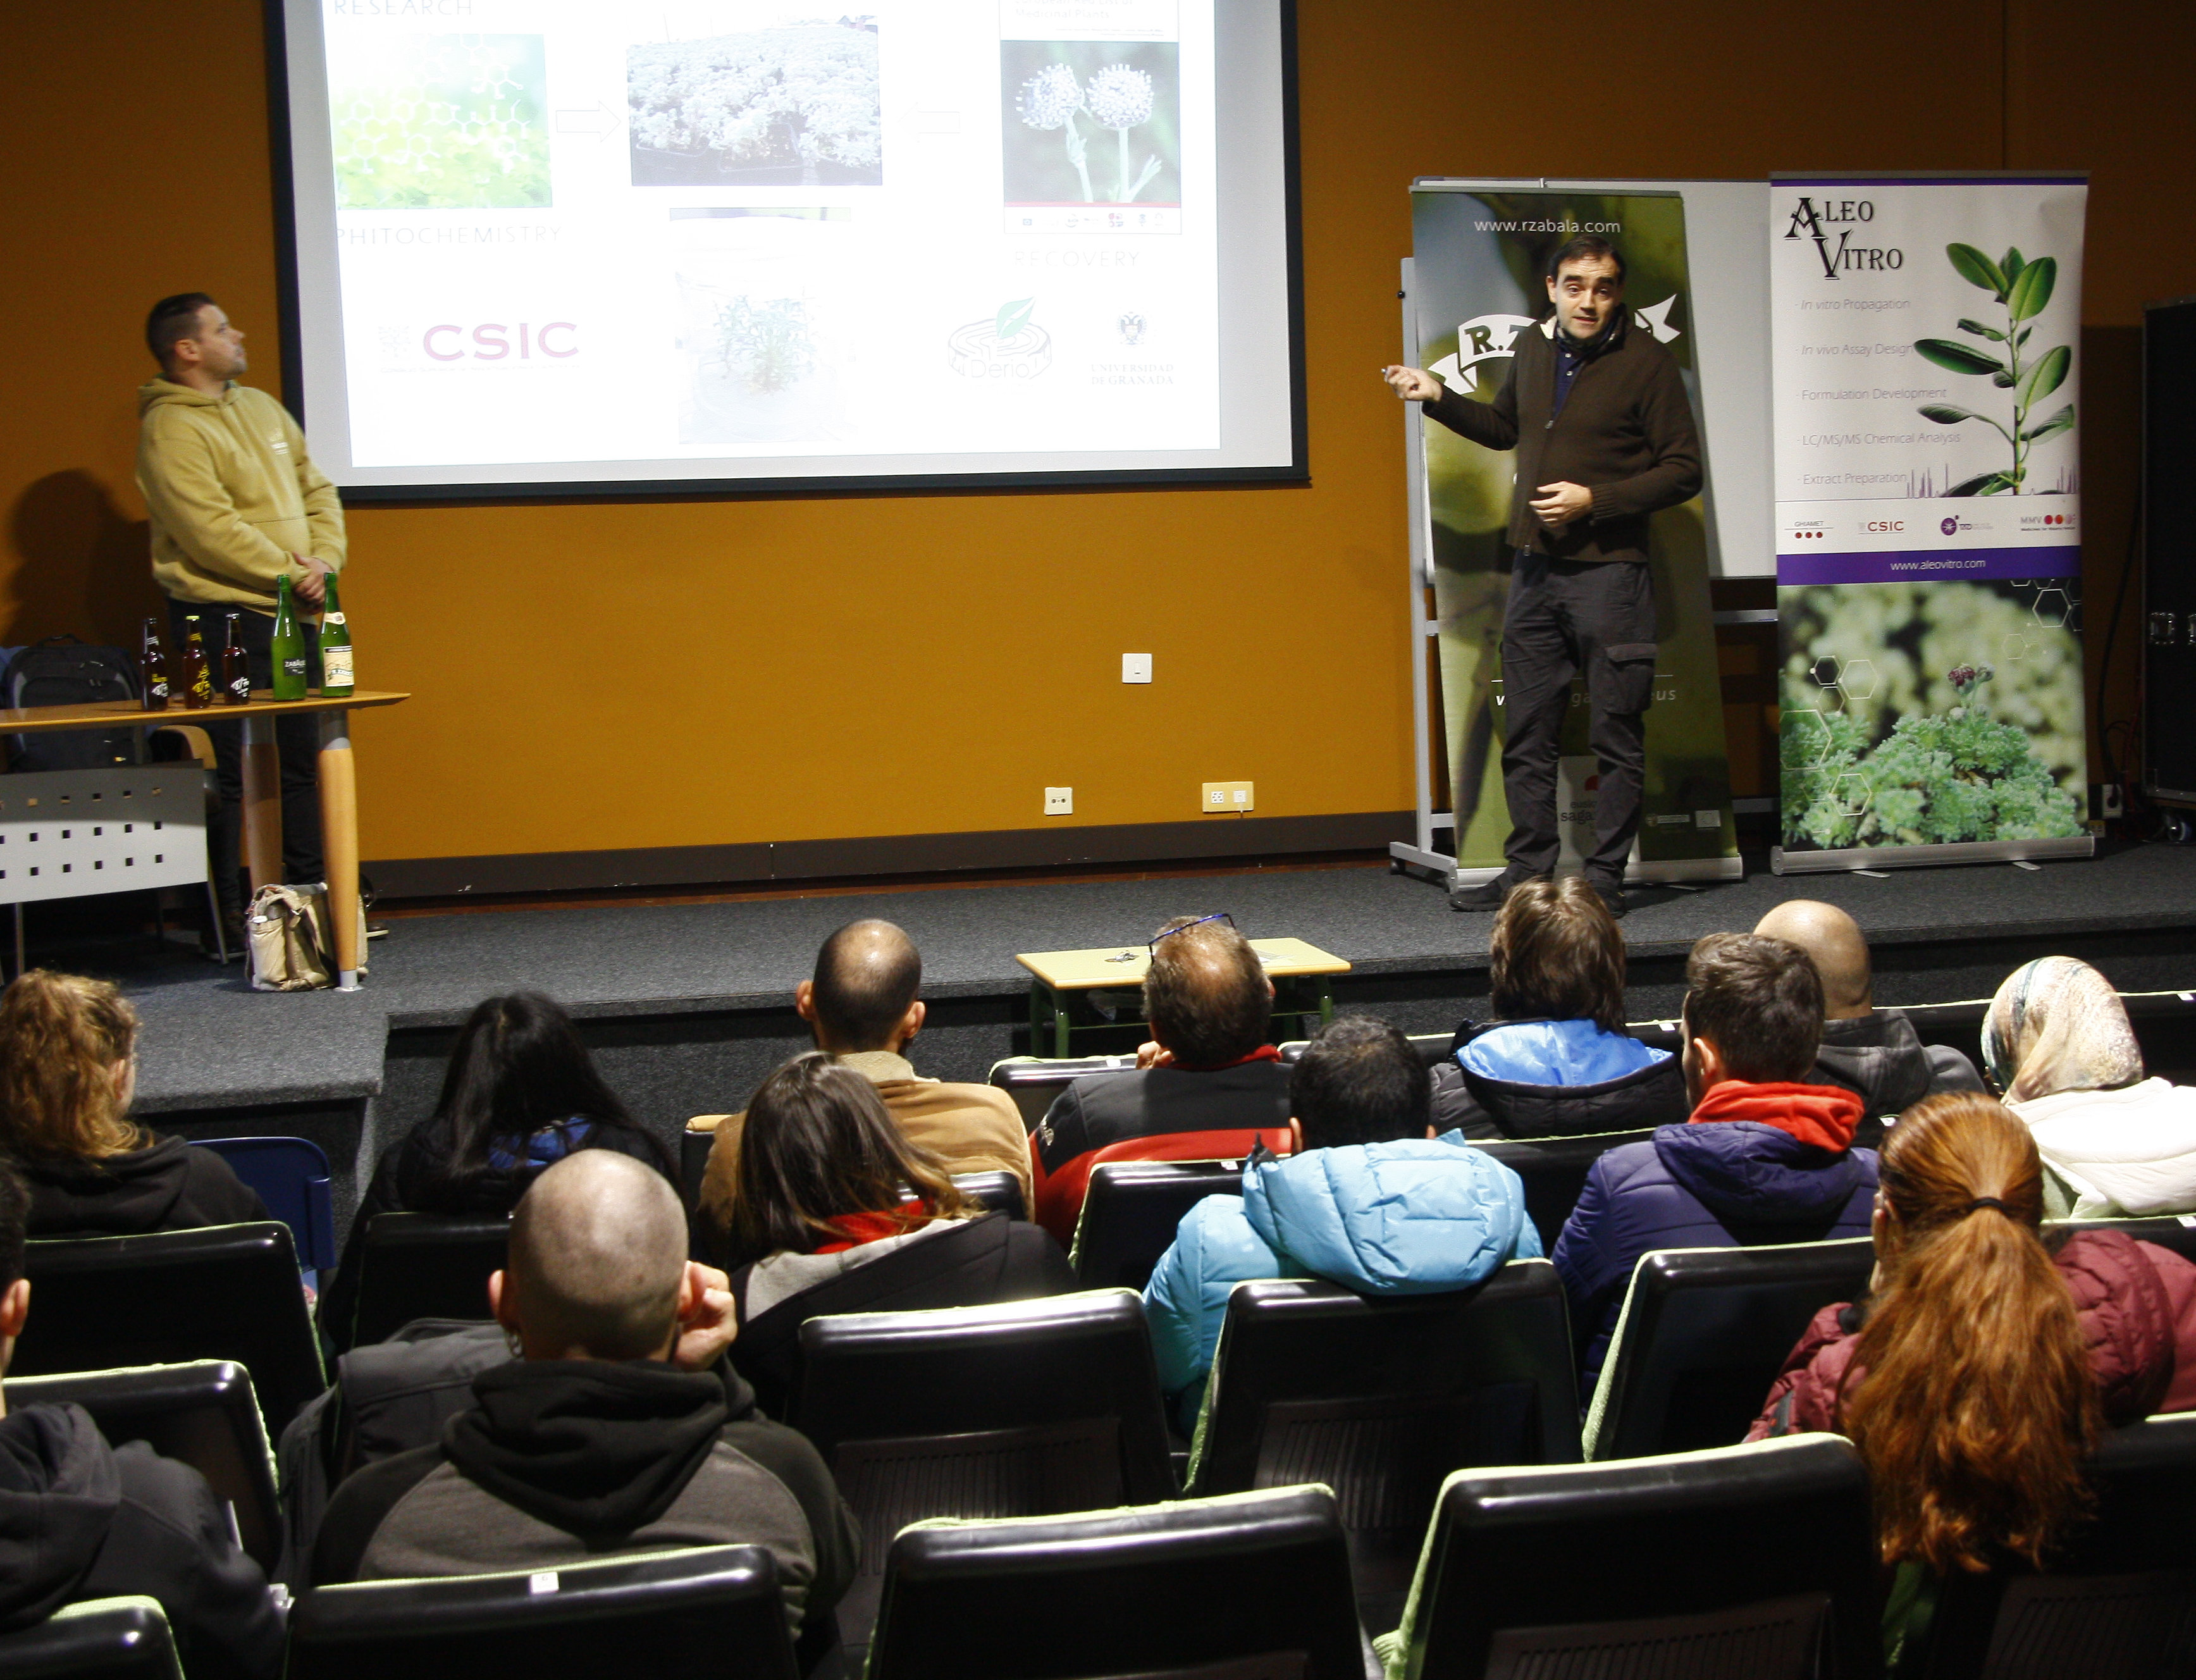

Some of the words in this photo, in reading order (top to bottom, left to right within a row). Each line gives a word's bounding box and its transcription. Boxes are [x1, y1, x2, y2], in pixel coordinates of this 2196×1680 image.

[333, 0, 472, 15] RESEARCH
[1474, 218, 1621, 233] www.rzabala.com
[338, 226, 562, 245] PHITOCHEMISTRY
[1014, 250, 1140, 267] RECOVERY
[1801, 300, 1812, 310] In
[1816, 299, 1841, 309] vitro
[1843, 299, 1911, 312] Propagation
[423, 321, 580, 362] CSIC
[1801, 345, 1813, 355] In
[1816, 345, 1839, 355] vivo
[1841, 344, 1873, 357] Assay
[1875, 343, 1914, 357] Design
[971, 359, 1030, 378] Derio
[1091, 364, 1175, 373] UNIVERSIDAD
[1091, 376, 1106, 385] DE
[1107, 376, 1175, 385] GRANADA
[1802, 390, 1869, 400] Formulation
[1872, 388, 1947, 400] Development
[1802, 434, 1862, 447] LC/MS/MS
[1865, 433, 1916, 444] Chemical
[1917, 433, 1961, 445] Analysis
[1803, 474, 1842, 485] Extract
[1844, 472, 1908, 486] Preparation
[1868, 521, 1904, 532] CSIC
[1890, 559, 1986, 571] www.aleovitro.com
